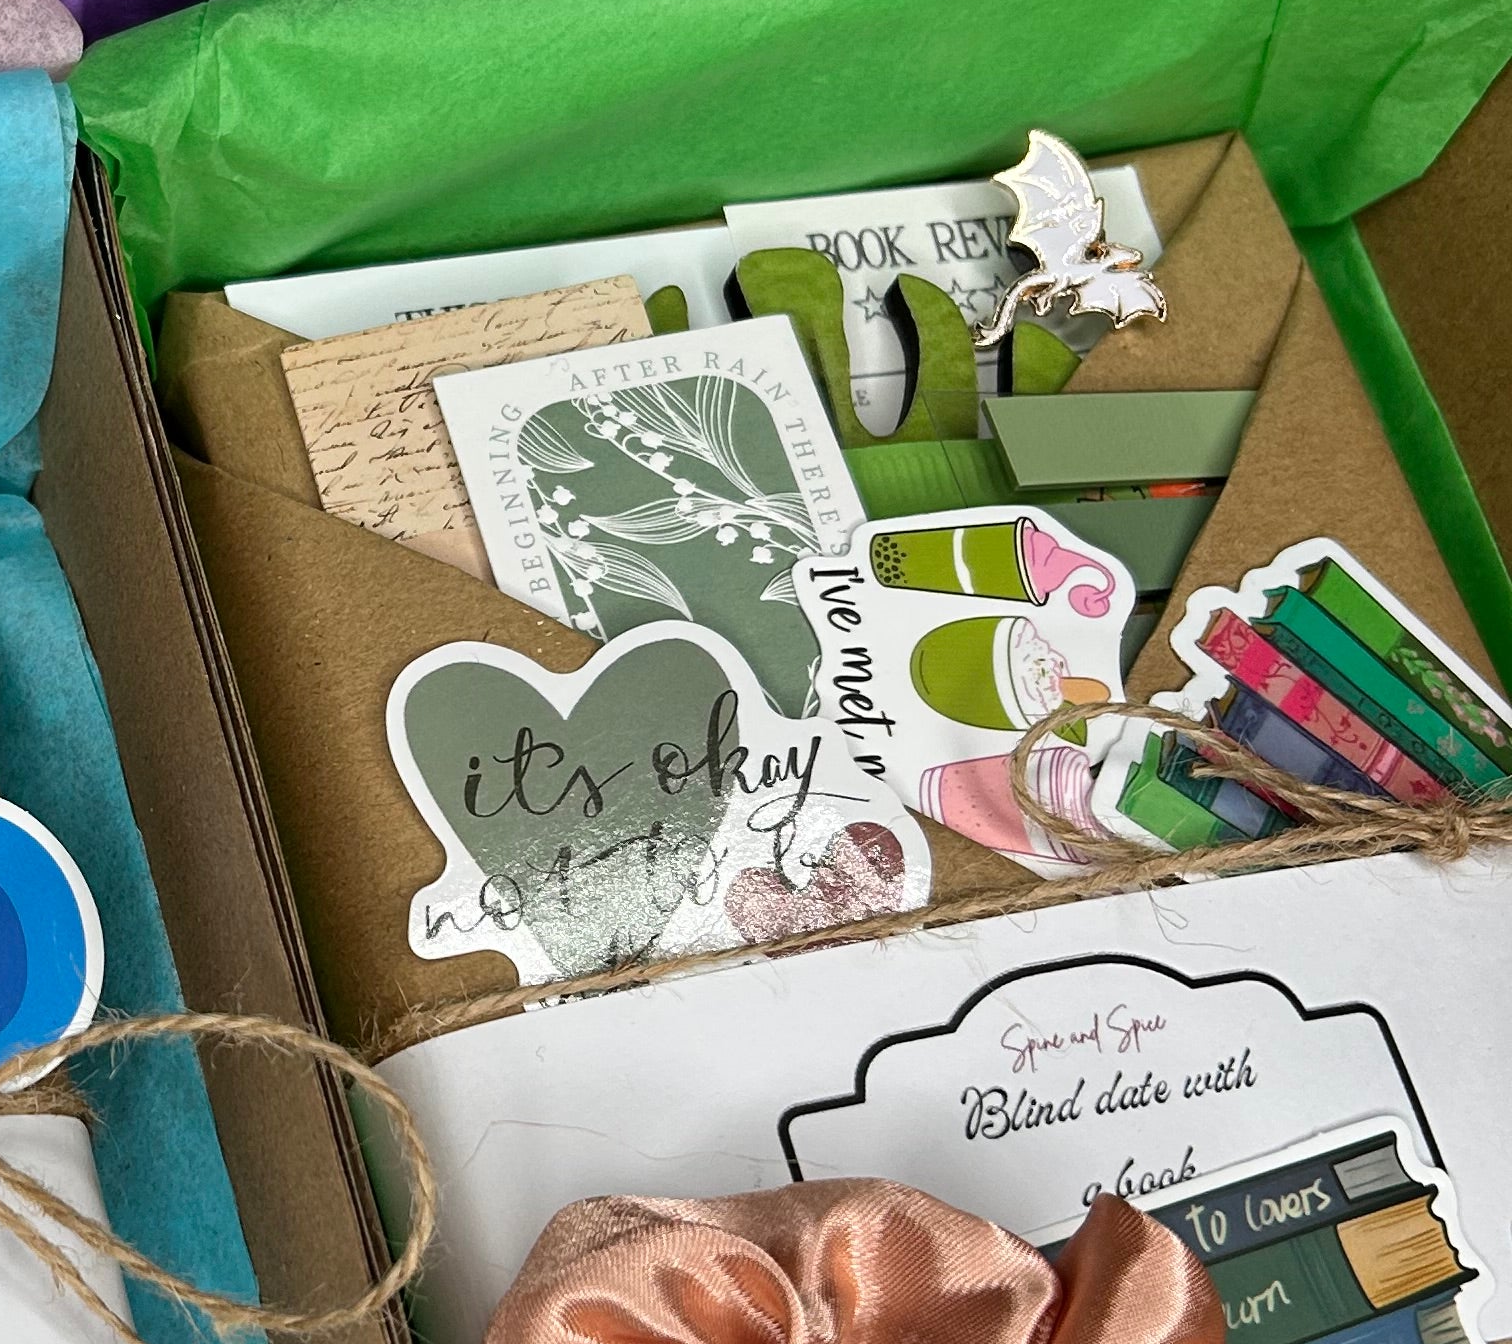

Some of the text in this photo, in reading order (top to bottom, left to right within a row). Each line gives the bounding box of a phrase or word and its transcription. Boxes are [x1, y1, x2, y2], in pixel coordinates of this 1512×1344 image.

[806, 215, 1014, 272] BOOK REV
[569, 354, 682, 392] AFTER
[704, 351, 791, 403] RAIN
[488, 402, 551, 595] BEGINNING
[809, 567, 865, 633] I've
[652, 690, 871, 833] okay
[1000, 1003, 1167, 1074] Spine and Spice
[960, 1046, 1257, 1140] Blind date with
[1115, 1146, 1197, 1199] book
[1244, 1177, 1332, 1233] lovers
